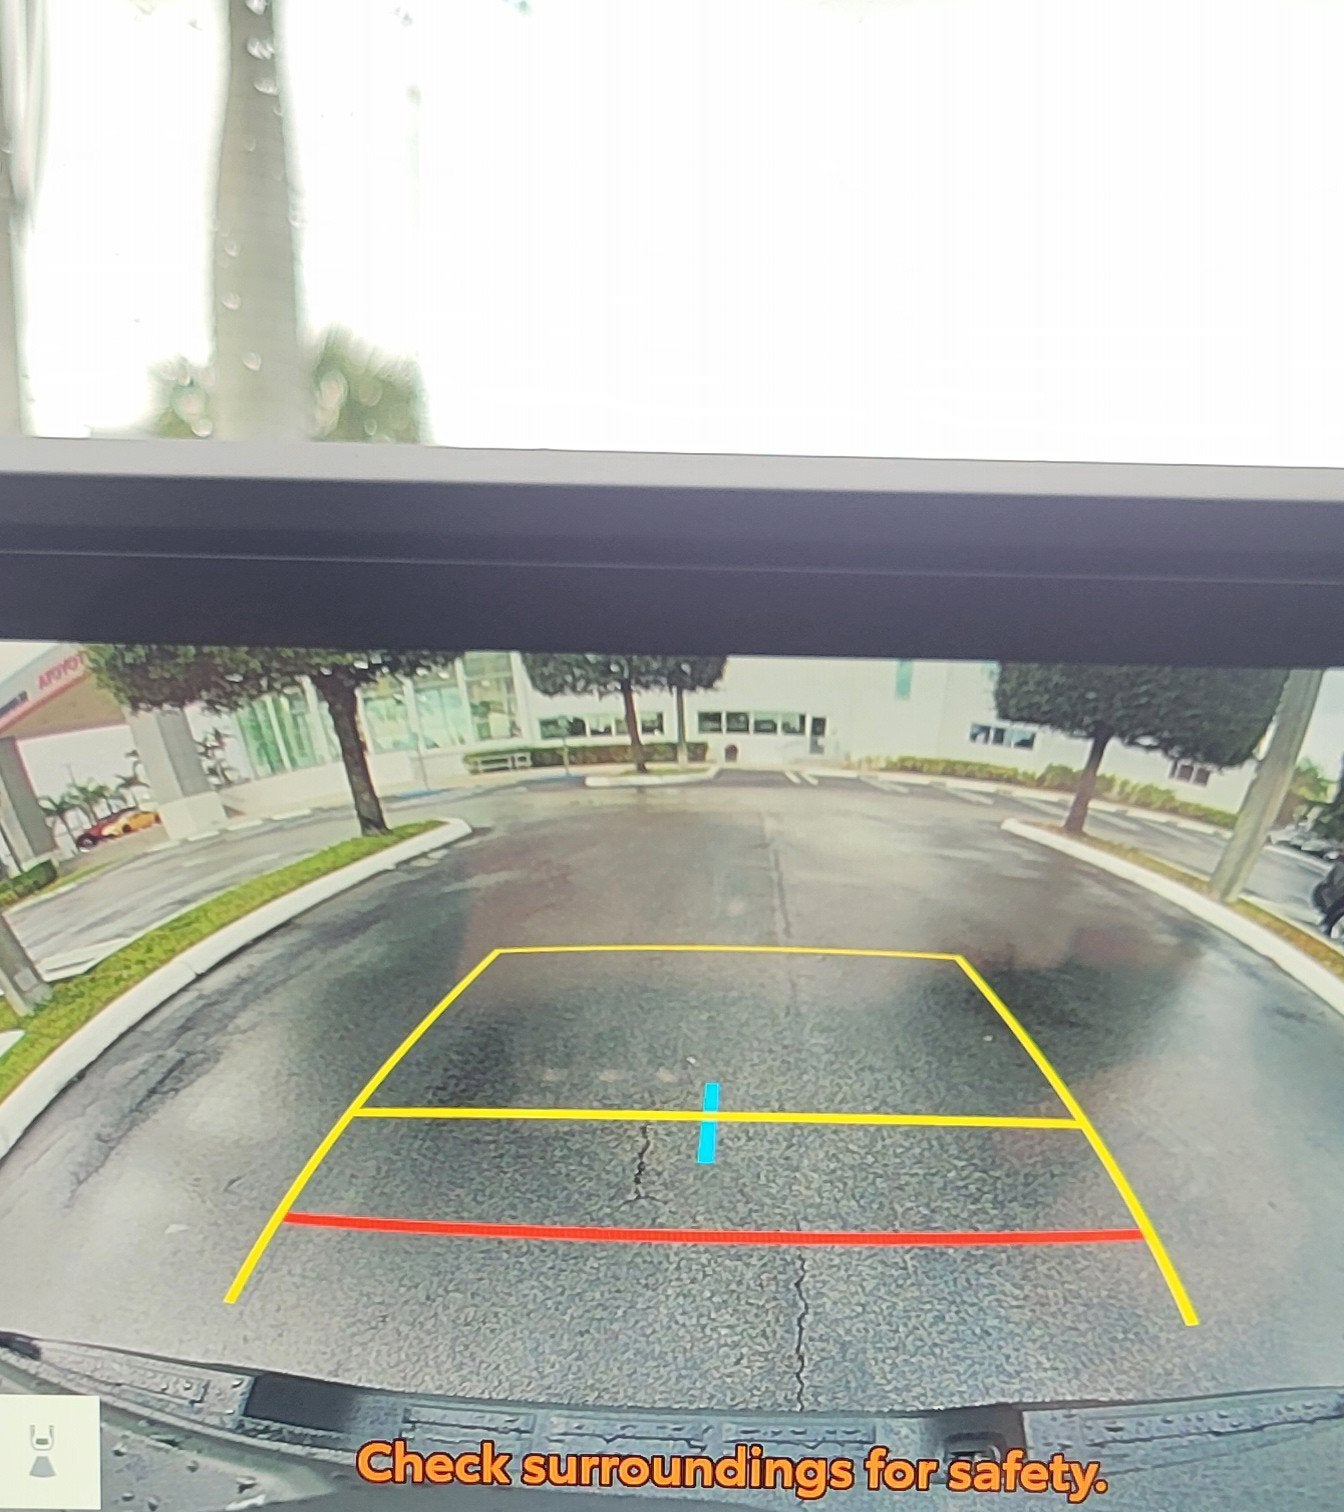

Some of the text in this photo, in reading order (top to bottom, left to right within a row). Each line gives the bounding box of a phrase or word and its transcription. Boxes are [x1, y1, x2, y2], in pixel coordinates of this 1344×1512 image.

[356, 1439, 1109, 1504] Check surroundings for safety.
